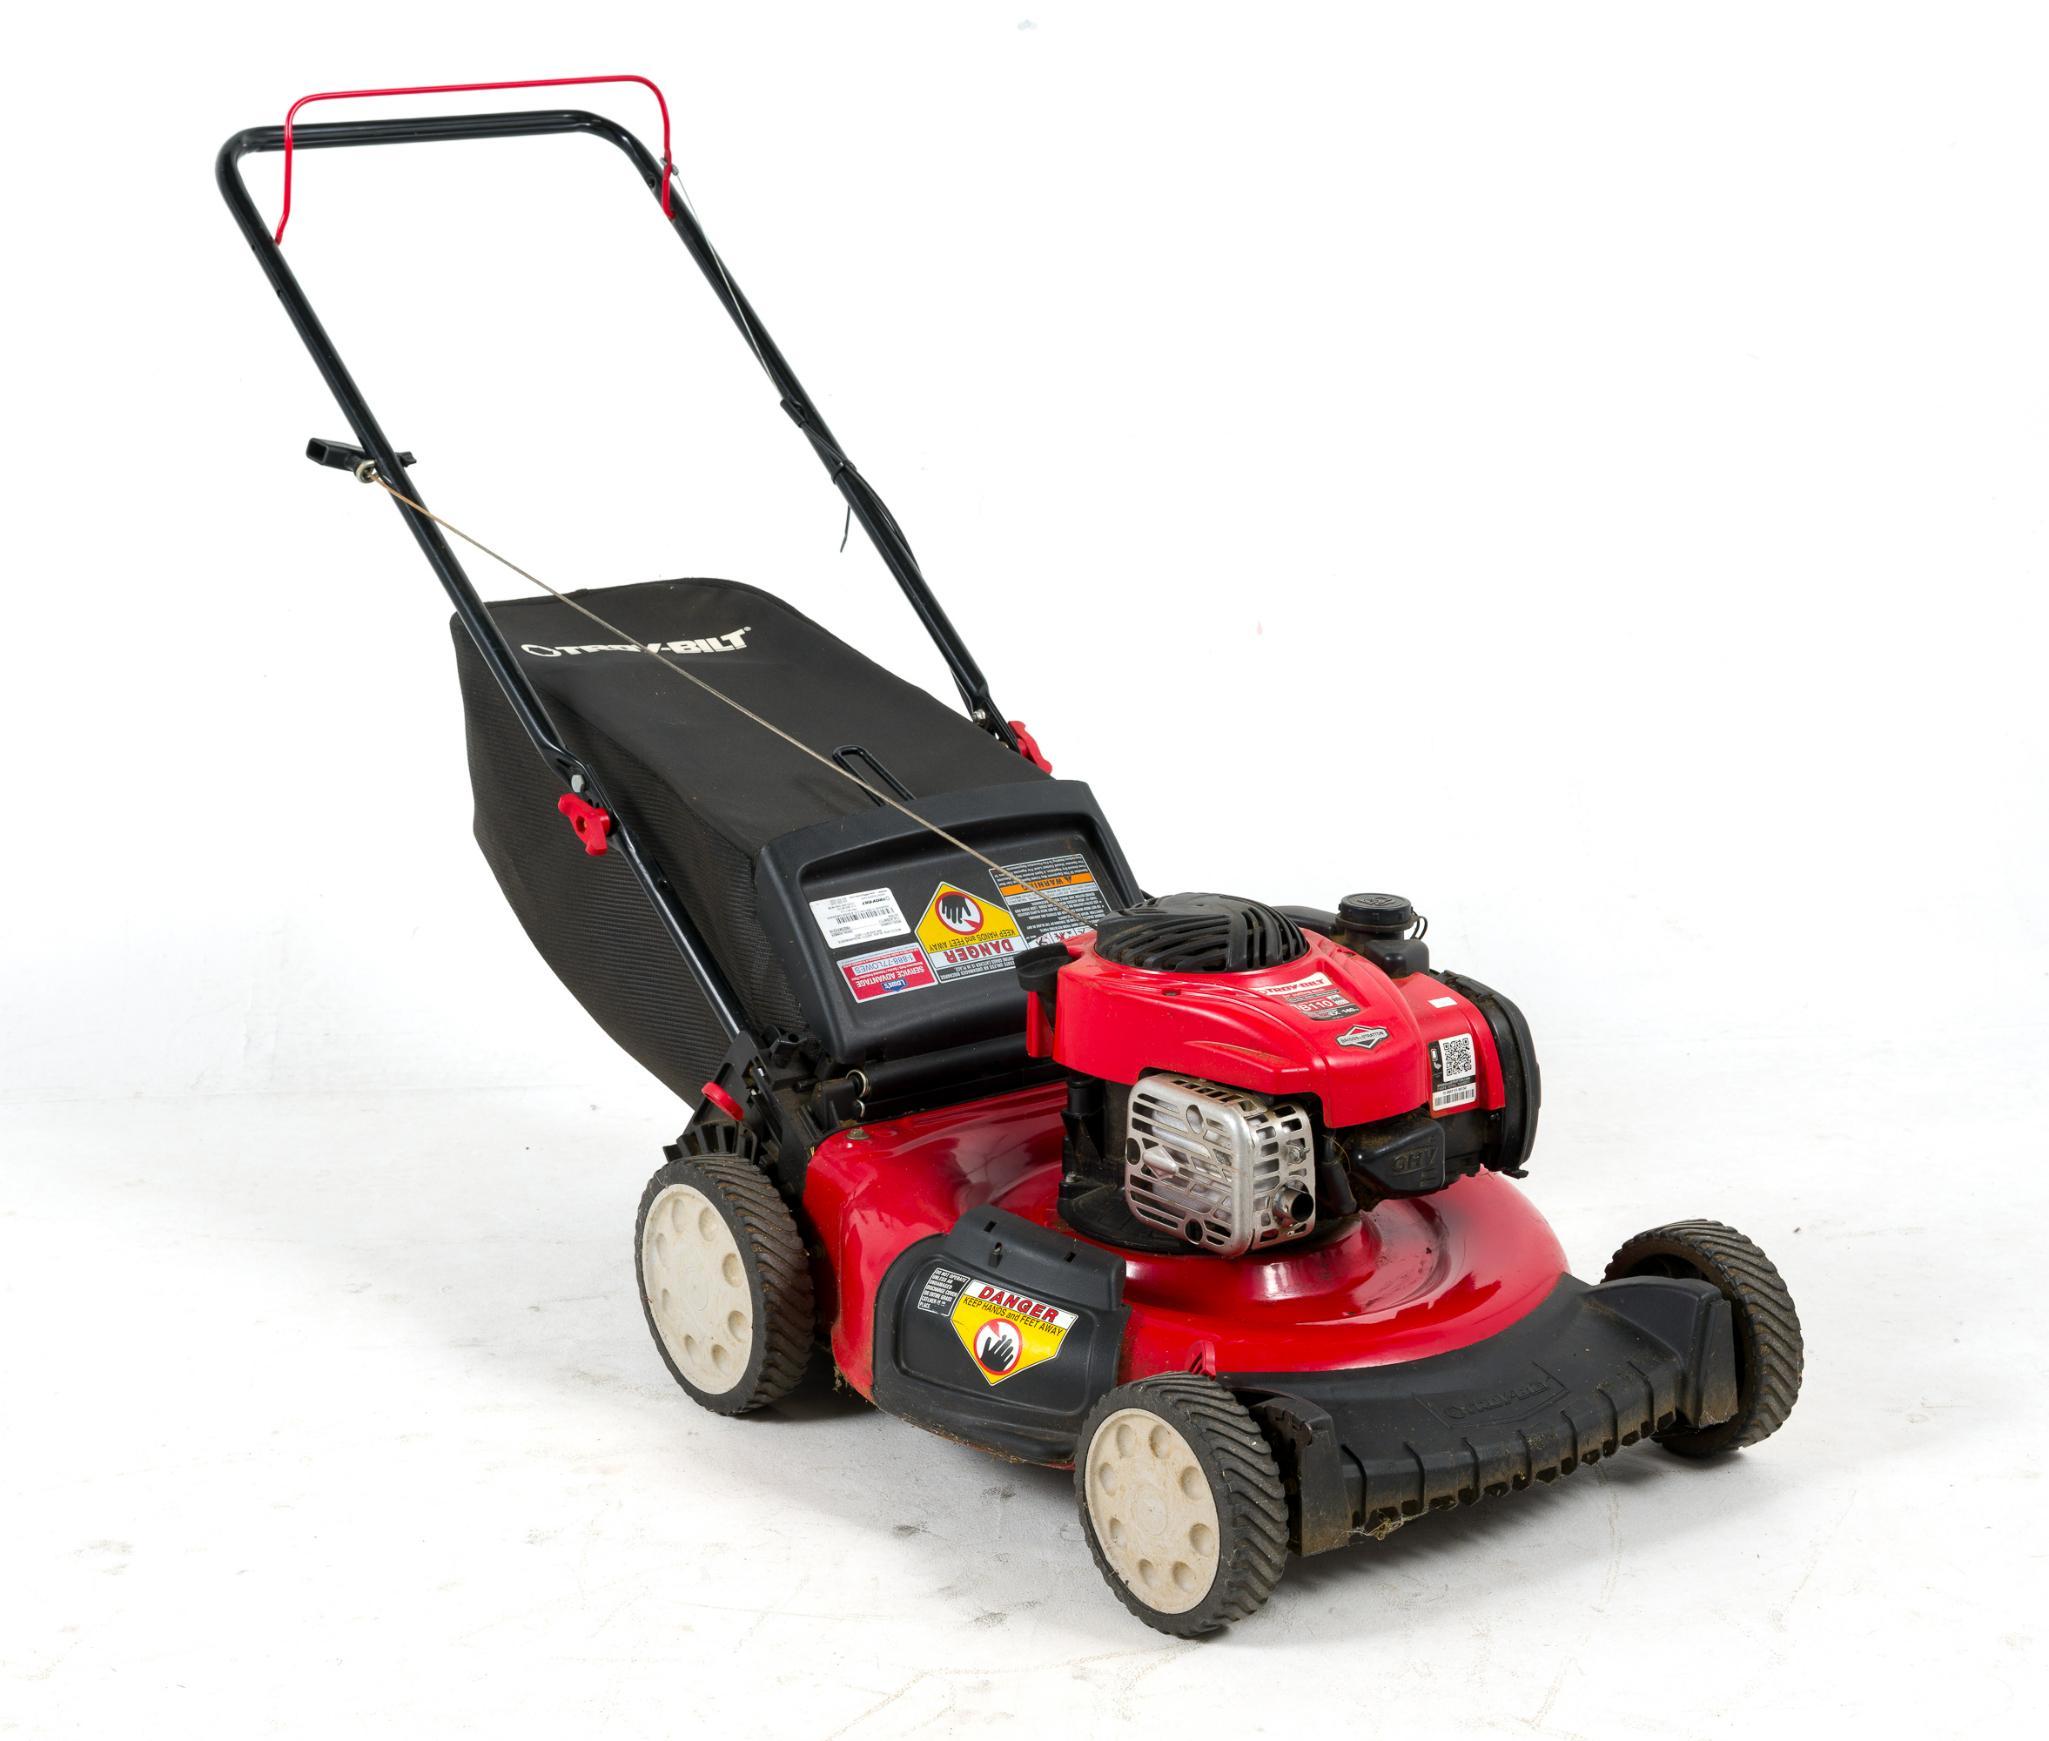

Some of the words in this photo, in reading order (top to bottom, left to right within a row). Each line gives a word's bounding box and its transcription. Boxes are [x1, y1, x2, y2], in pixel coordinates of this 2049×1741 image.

[976, 931, 998, 941] HANDS
[998, 929, 1015, 937] KEEP
[948, 938, 965, 948] FEET
[965, 936, 977, 944] and
[929, 941, 948, 952] AWAY
[944, 938, 1015, 964] DANGER
[897, 965, 924, 978] SERVICE
[856, 971, 896, 987] ADVANTAGE
[978, 1286, 1060, 1324] DANGER
[962, 1296, 982, 1308] KEEP
[982, 1303, 1007, 1317] HANDS
[1005, 1310, 1020, 1322] and
[1019, 1315, 1041, 1329] FEET
[1039, 1322, 1064, 1337] AWAY
